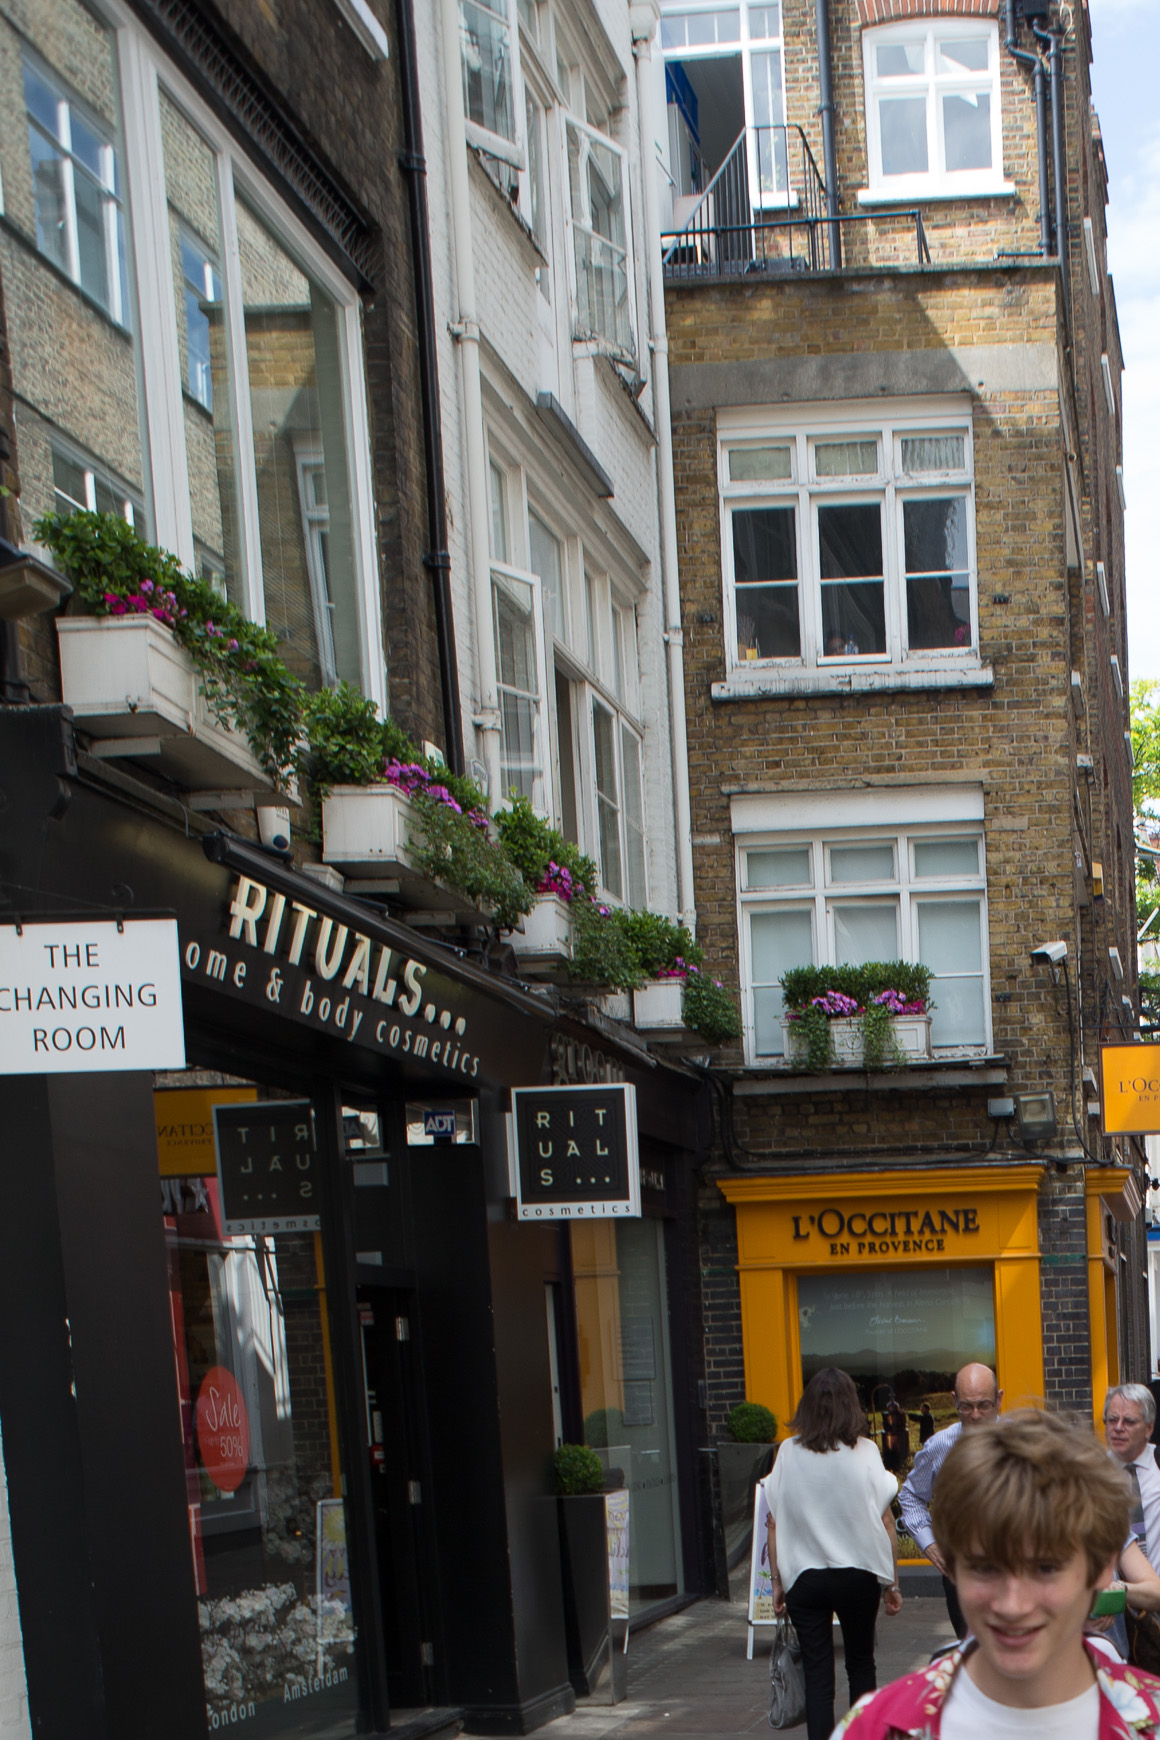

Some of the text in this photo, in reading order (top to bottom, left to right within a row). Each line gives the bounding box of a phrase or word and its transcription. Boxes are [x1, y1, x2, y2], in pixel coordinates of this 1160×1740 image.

[43, 943, 100, 969] THE
[0, 982, 157, 1012] CHANGING
[185, 941, 480, 1078] ome & body cosmetics
[33, 1025, 126, 1052] ROOM
[1138, 1094, 1150, 1102] EN
[424, 1114, 456, 1133] ADT
[522, 1202, 631, 1218] cosmetics
[792, 1207, 980, 1241] L'OCCITANE
[829, 1238, 946, 1256] EN PROVENCE
[205, 1386, 241, 1432] Sale
[220, 1436, 243, 1457] 50%
[284, 1665, 349, 1703] Amsterdam
